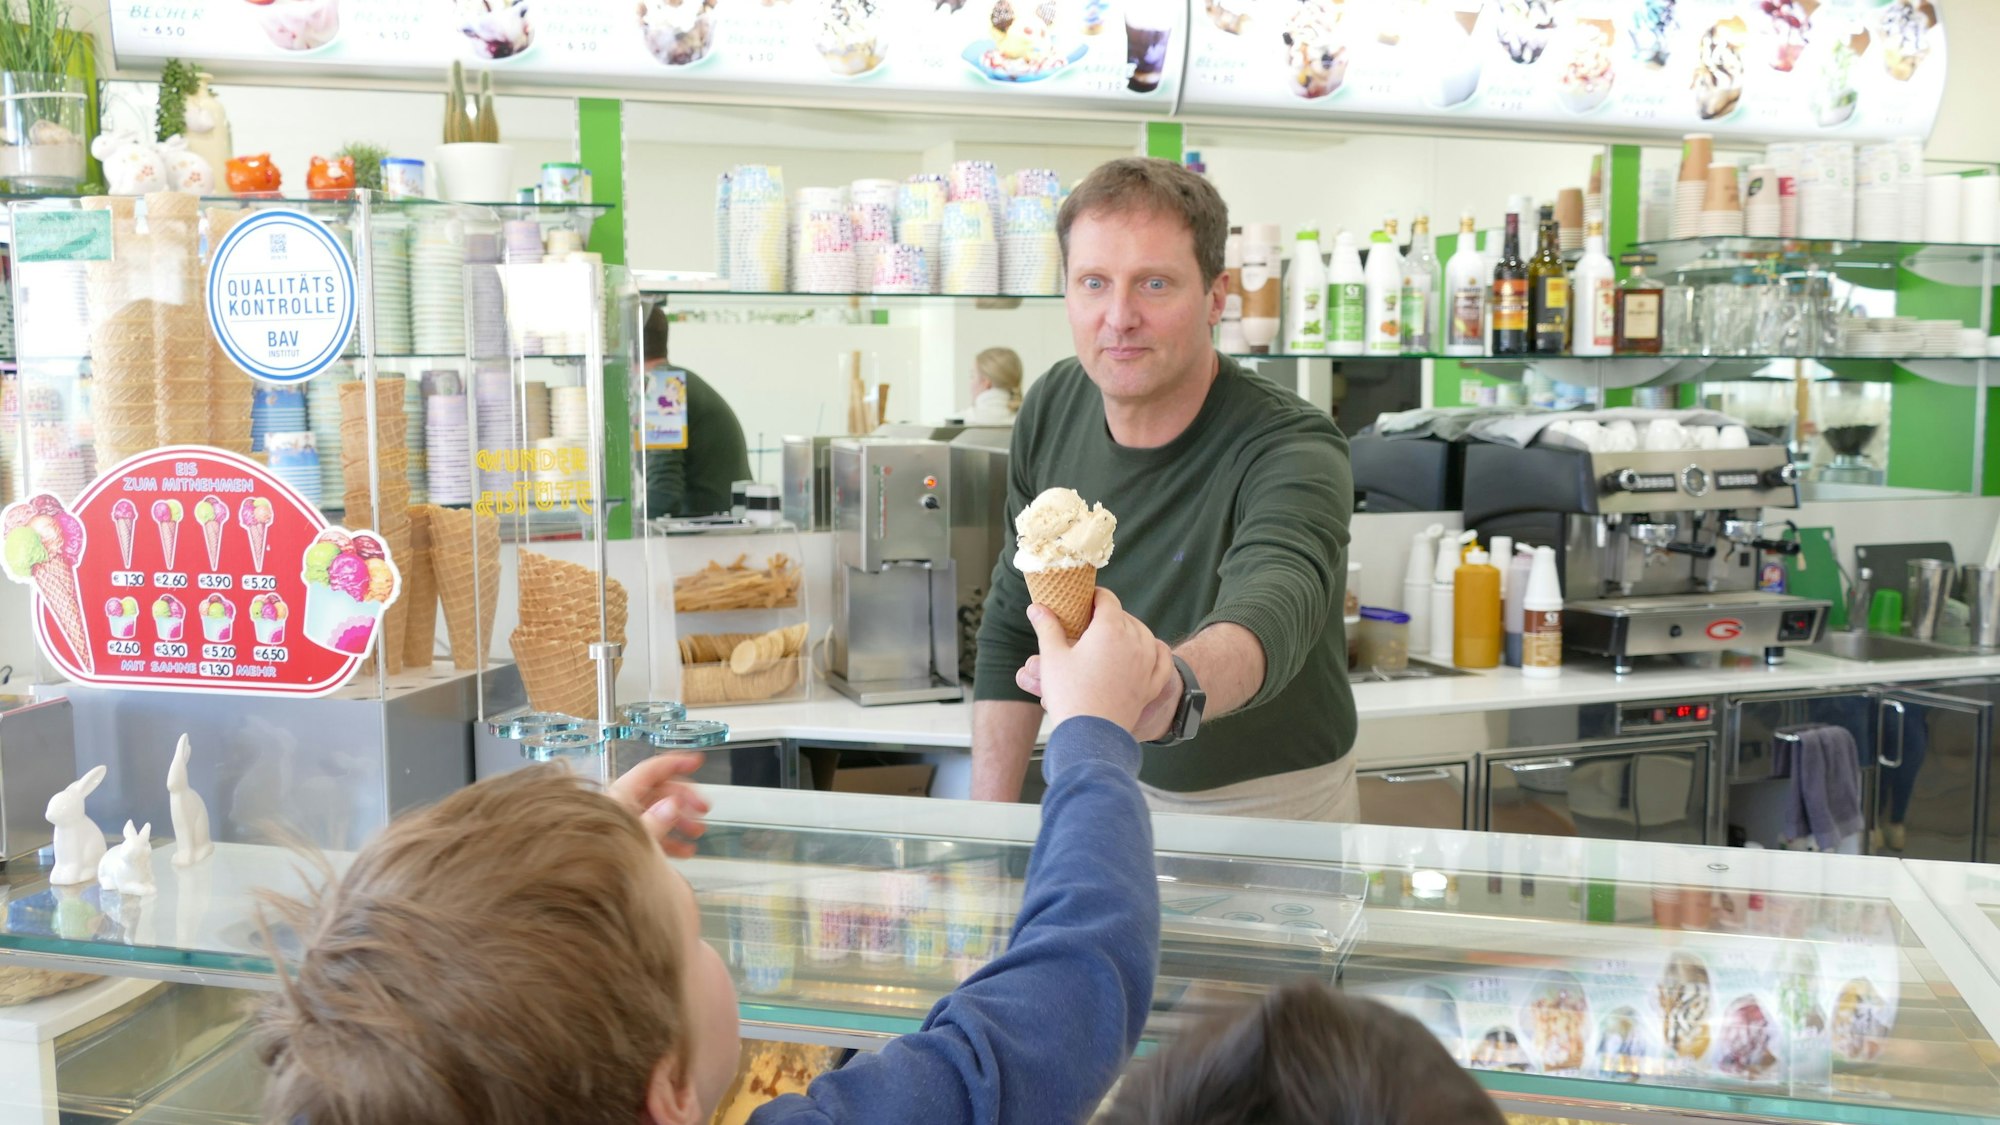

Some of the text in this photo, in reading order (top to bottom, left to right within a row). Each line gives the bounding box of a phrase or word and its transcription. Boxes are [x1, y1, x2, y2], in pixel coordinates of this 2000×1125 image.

[227, 274, 335, 297] QUALITÄTS
[229, 297, 336, 316] KONTROLLE
[267, 330, 299, 347] BAV
[268, 350, 300, 358] INSTITUT
[176, 462, 198, 476] EIS
[475, 448, 588, 475] WUNDER
[123, 477, 254, 492] ZUM MITNEHMEN
[121, 660, 146, 671] MIT
[151, 661, 197, 674] SAHNE
[236, 664, 277, 677] MEHR
